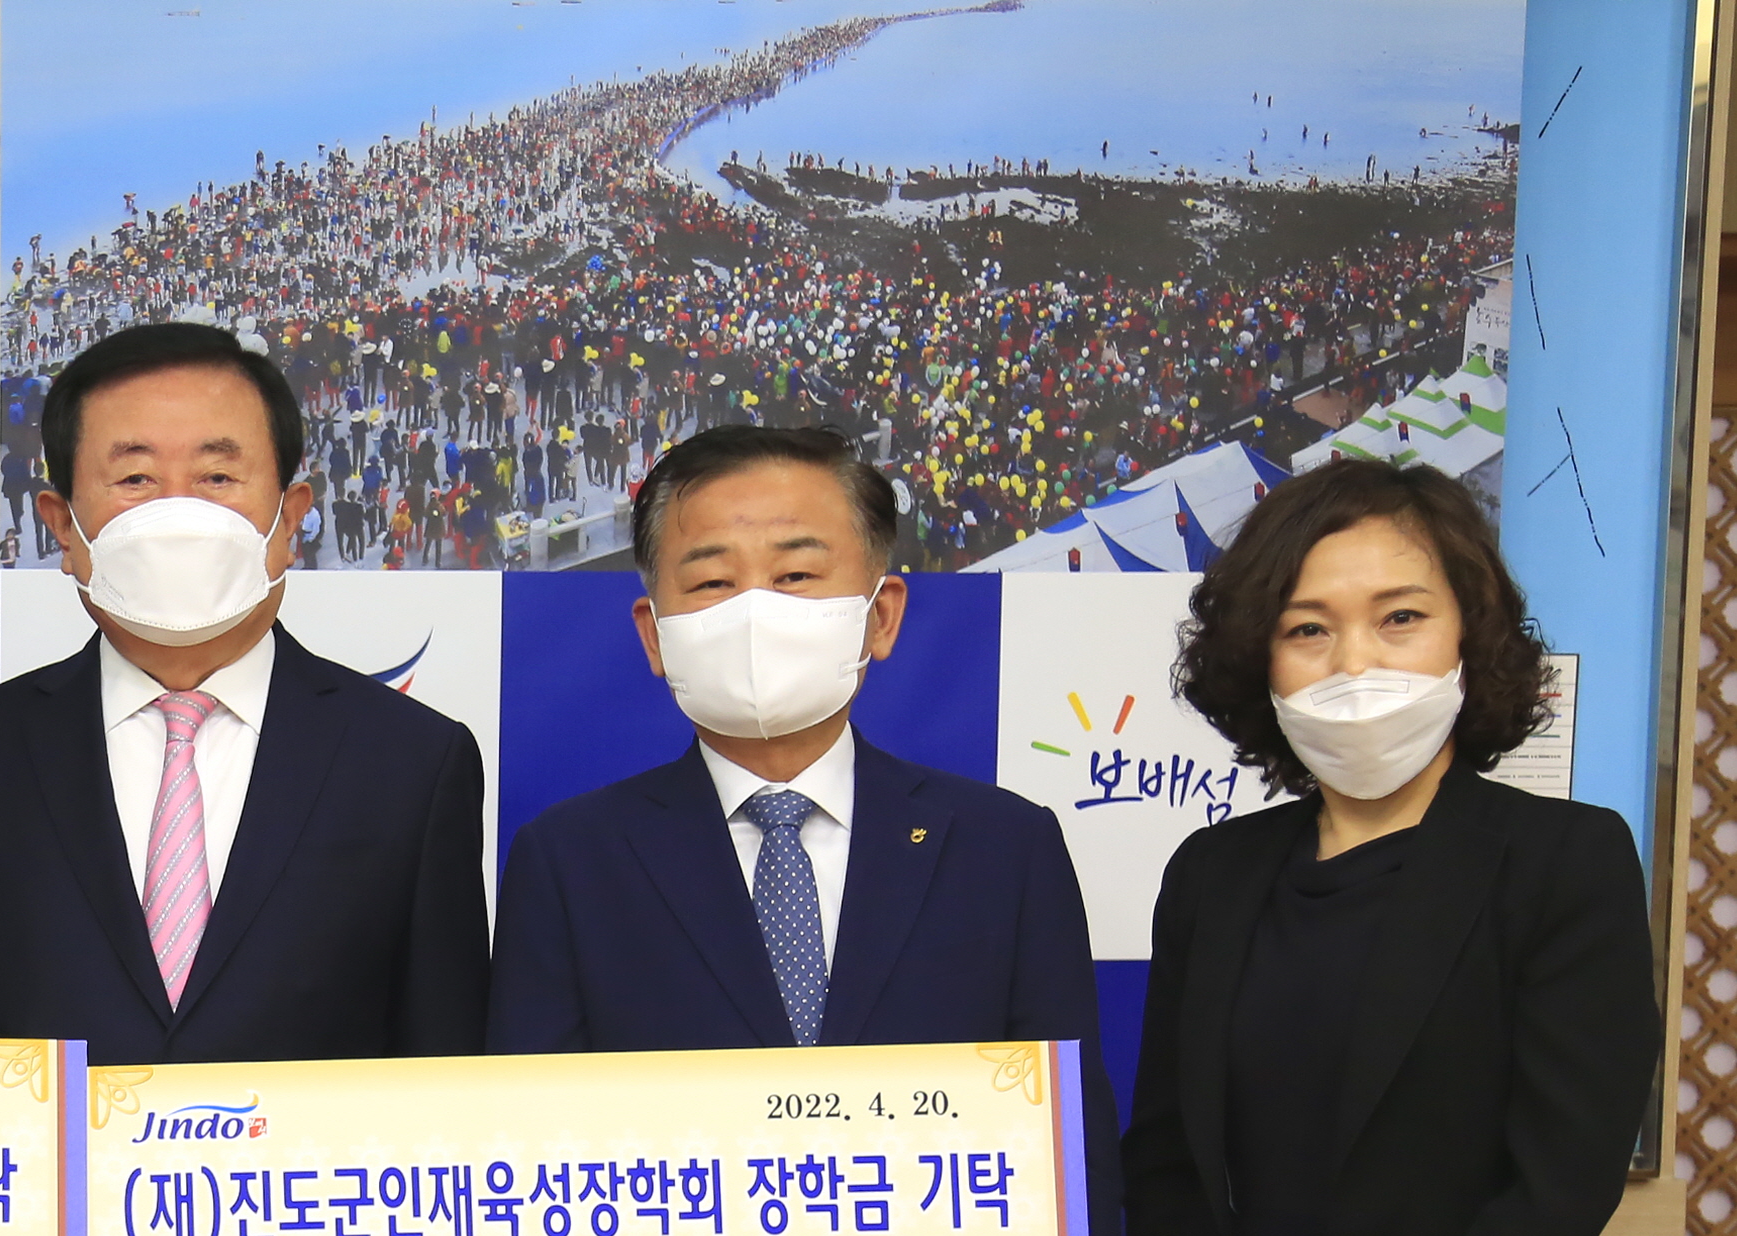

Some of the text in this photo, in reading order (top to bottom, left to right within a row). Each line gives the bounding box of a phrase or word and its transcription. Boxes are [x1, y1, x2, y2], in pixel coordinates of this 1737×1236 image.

[1074, 749, 1239, 827] 보배섬
[132, 1111, 244, 1143] Jindo
[767, 1090, 959, 1121] 2022. 4. 20.
[747, 1153, 894, 1235] 장학금
[918, 1151, 1015, 1229] 기탁
